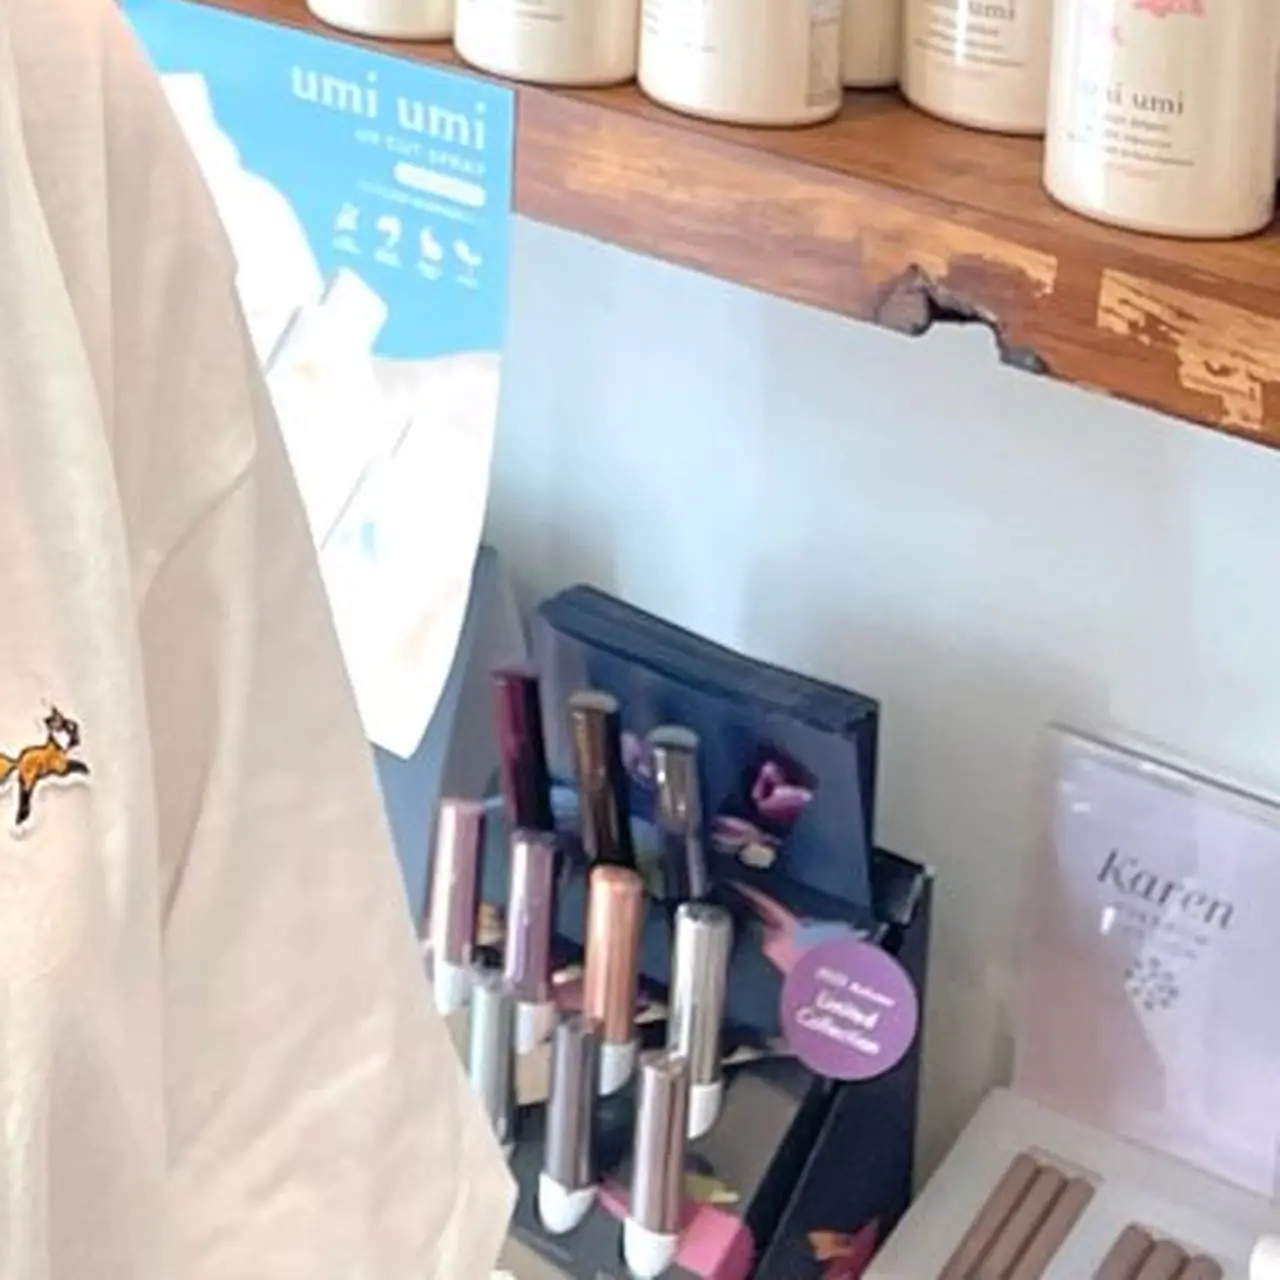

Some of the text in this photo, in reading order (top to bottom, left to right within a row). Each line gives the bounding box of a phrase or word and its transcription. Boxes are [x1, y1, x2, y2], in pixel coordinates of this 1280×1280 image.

[291, 64, 486, 151] umi umi
[1131, 88, 1185, 117] umi
[1095, 848, 1235, 930] Karen
[794, 1007, 881, 1058] Collection
